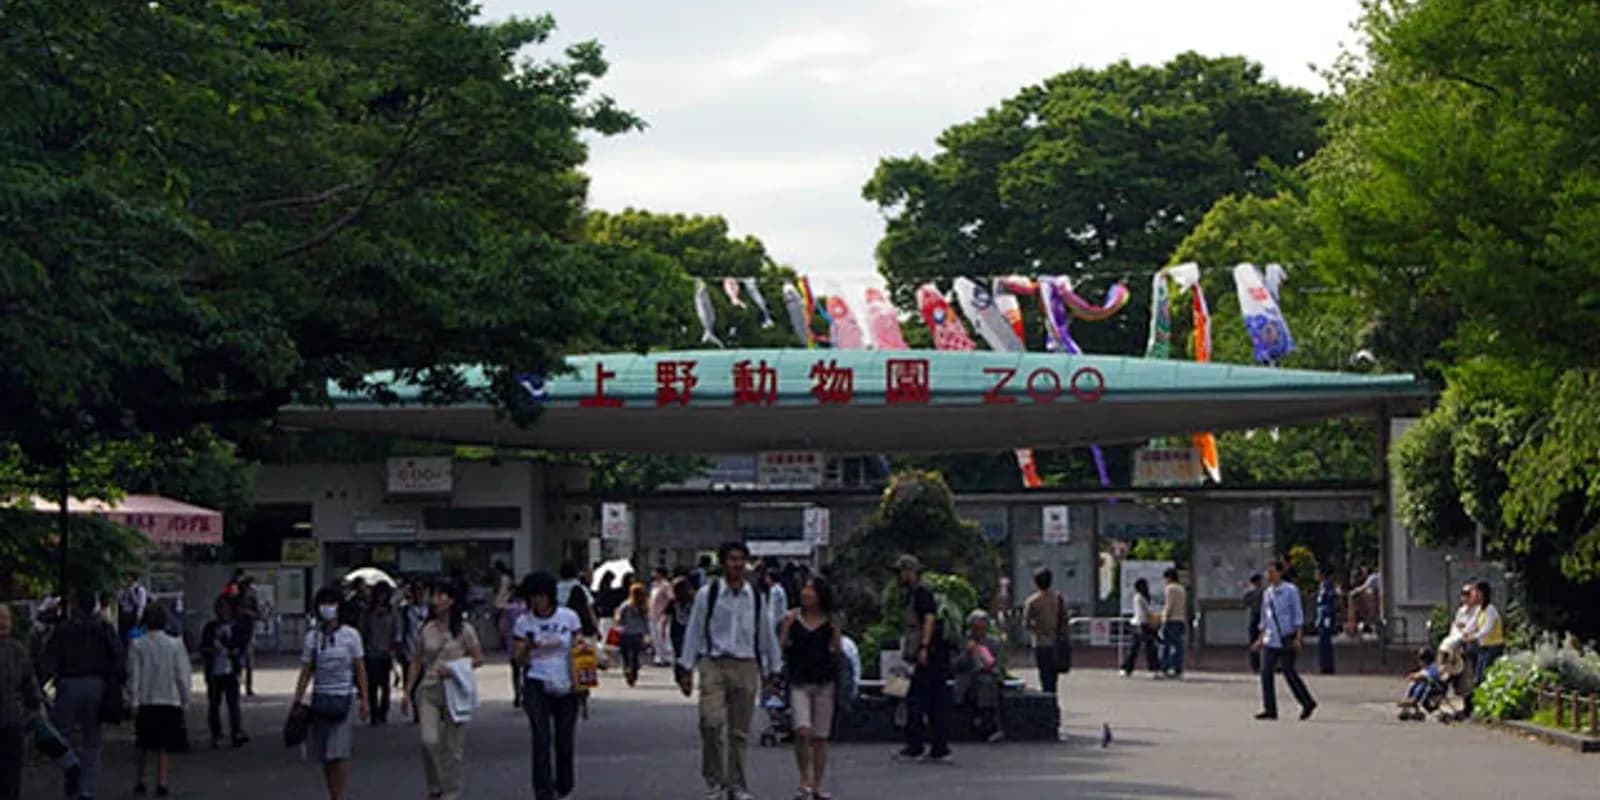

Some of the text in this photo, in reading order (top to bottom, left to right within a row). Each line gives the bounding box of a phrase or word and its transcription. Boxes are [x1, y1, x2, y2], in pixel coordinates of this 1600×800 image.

[579, 359, 1106, 408] 上野動物園 ZOO
